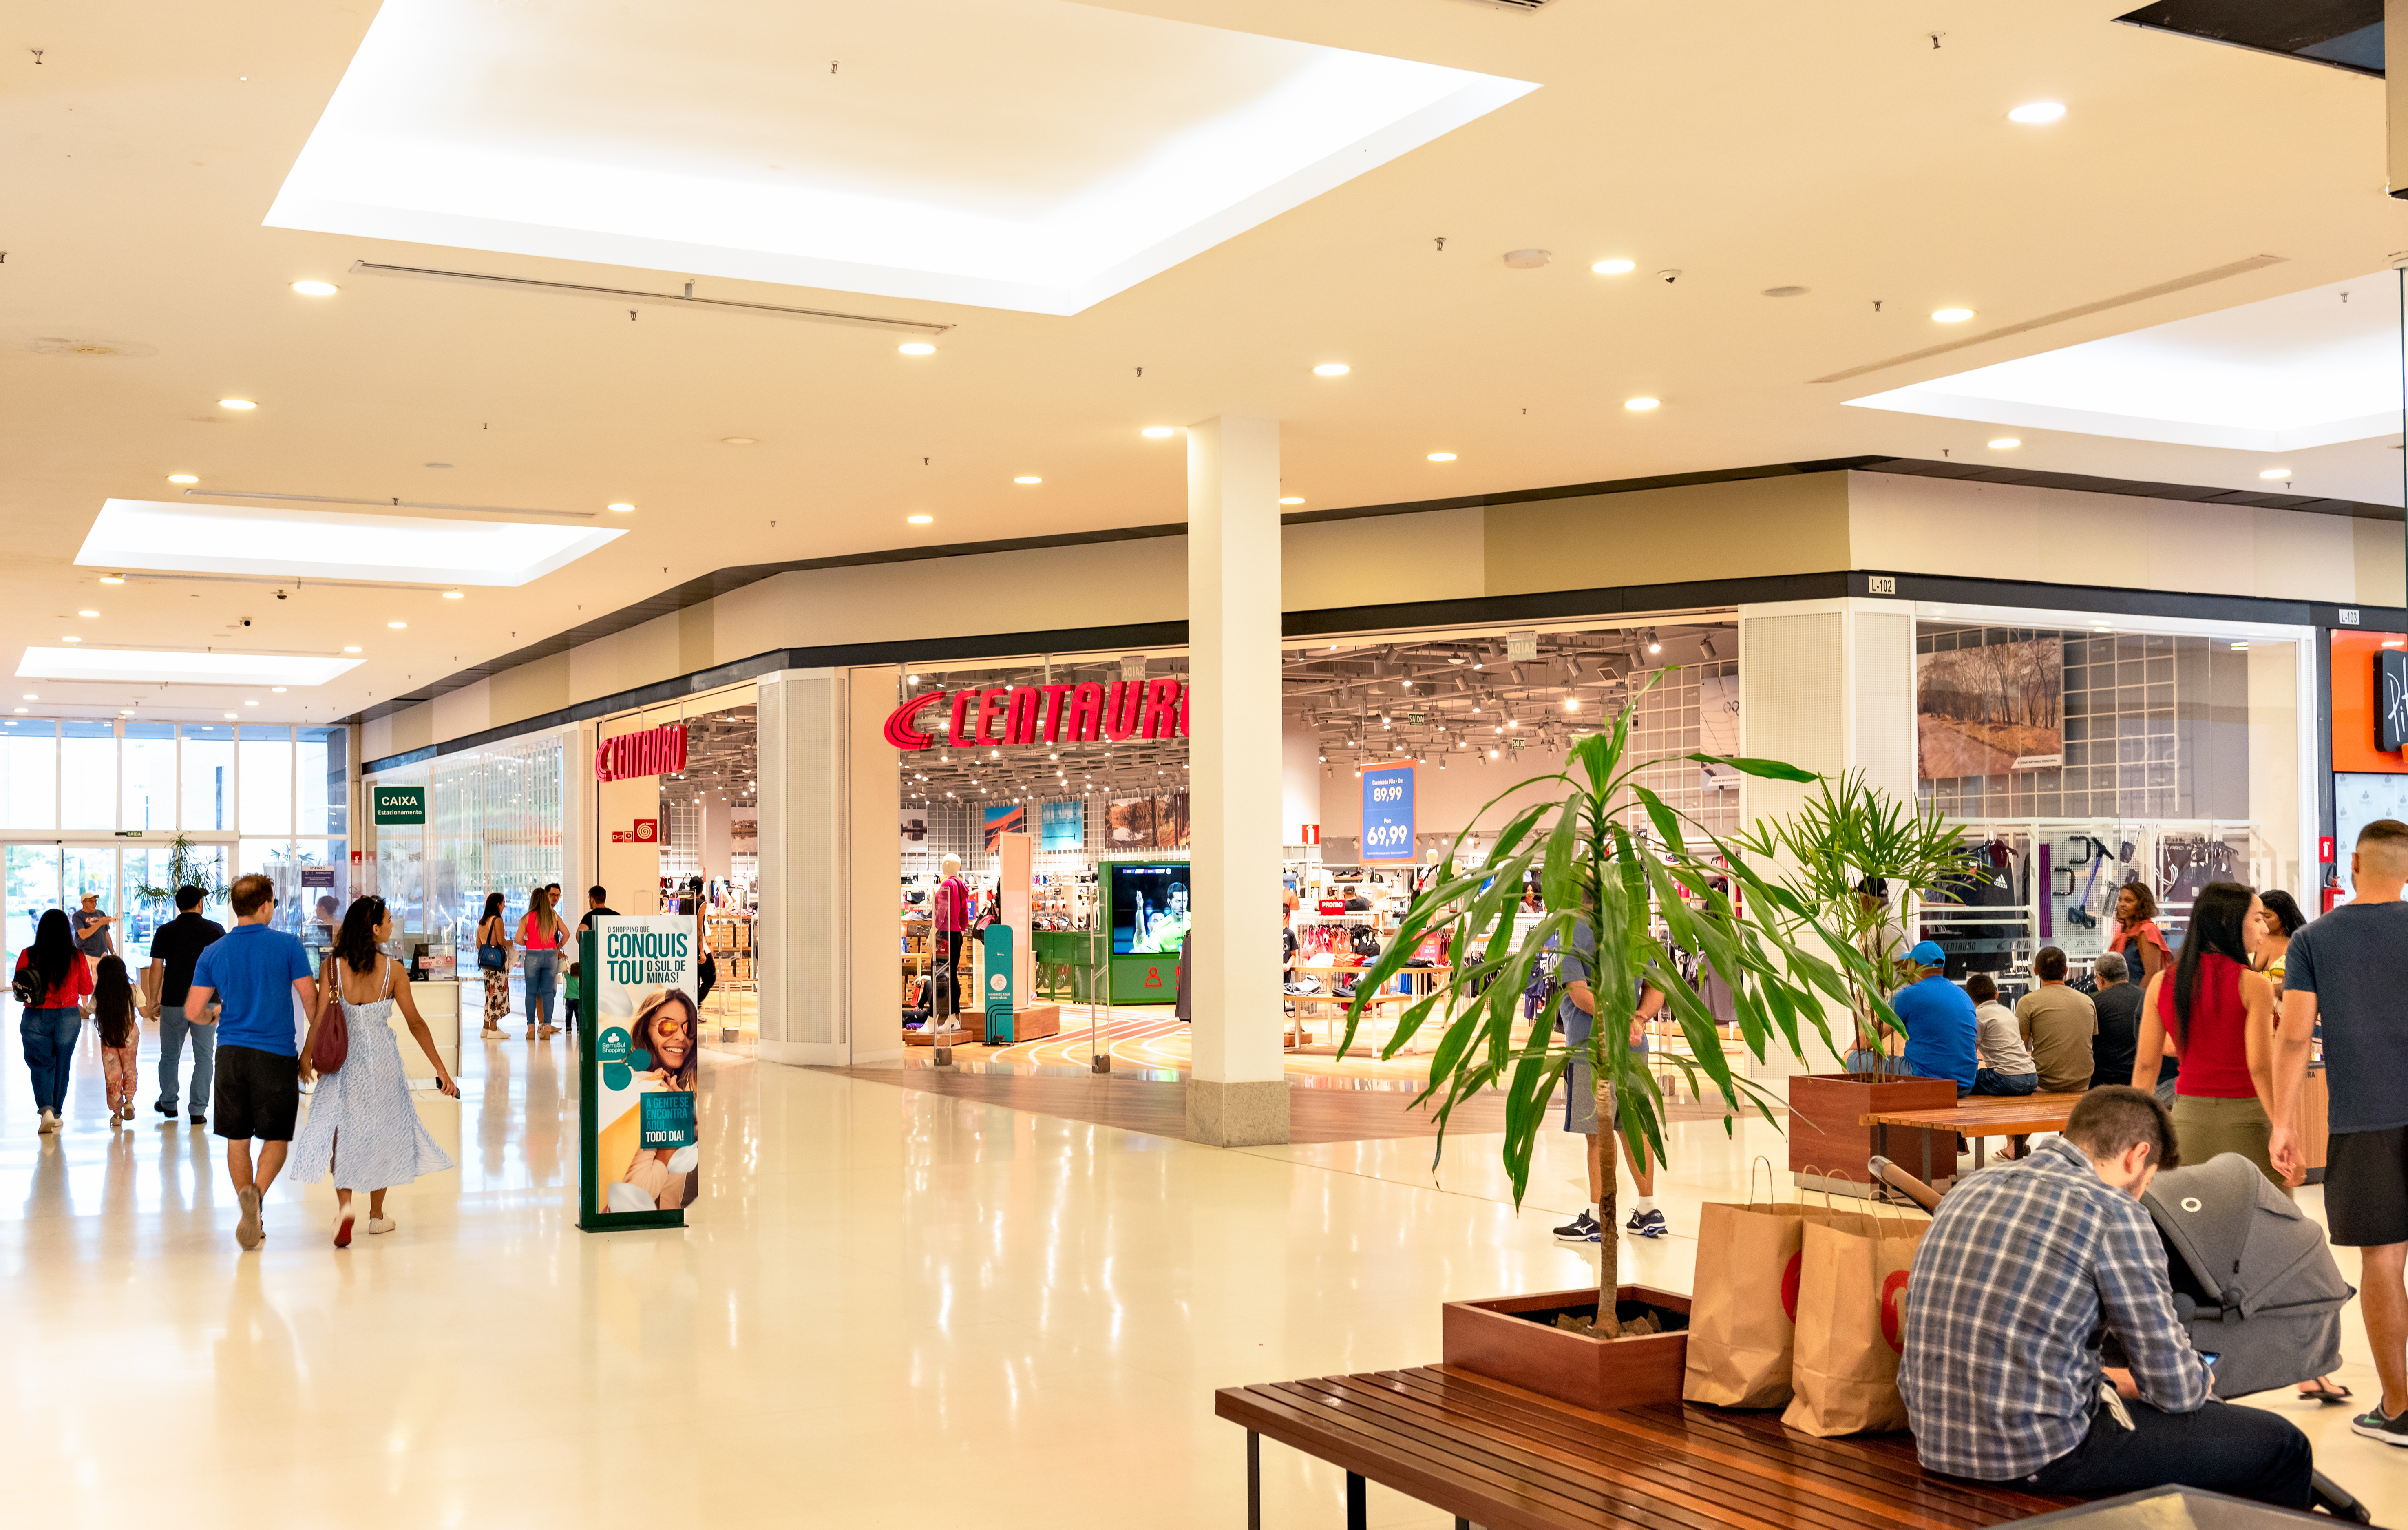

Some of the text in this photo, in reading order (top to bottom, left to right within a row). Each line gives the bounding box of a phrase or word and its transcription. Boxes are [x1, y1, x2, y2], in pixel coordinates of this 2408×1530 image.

[1872, 579, 1892, 592] L-102
[2342, 612, 2357, 623] L-103
[949, 679, 1189, 747] CENTAUR
[1409, 714, 1423, 723] SAÍDA
[611, 723, 683, 780] CENTAURO
[1374, 786, 1402, 802] 89,99
[382, 796, 418, 806] CAIXA
[1367, 825, 1407, 847] 69,99
[1994, 881, 2008, 889] adidas
[607, 933, 688, 960] CONQUIS
[647, 960, 686, 971] O SUL DE
[607, 960, 643, 985] TOU
[647, 972, 679, 984] MINAS!
[646, 1097, 689, 1108] A GENTE SE
[646, 1108, 687, 1120] ENCONTRA
[646, 1120, 667, 1131] AQUI,
[646, 1130, 684, 1142] TODO DIA!
